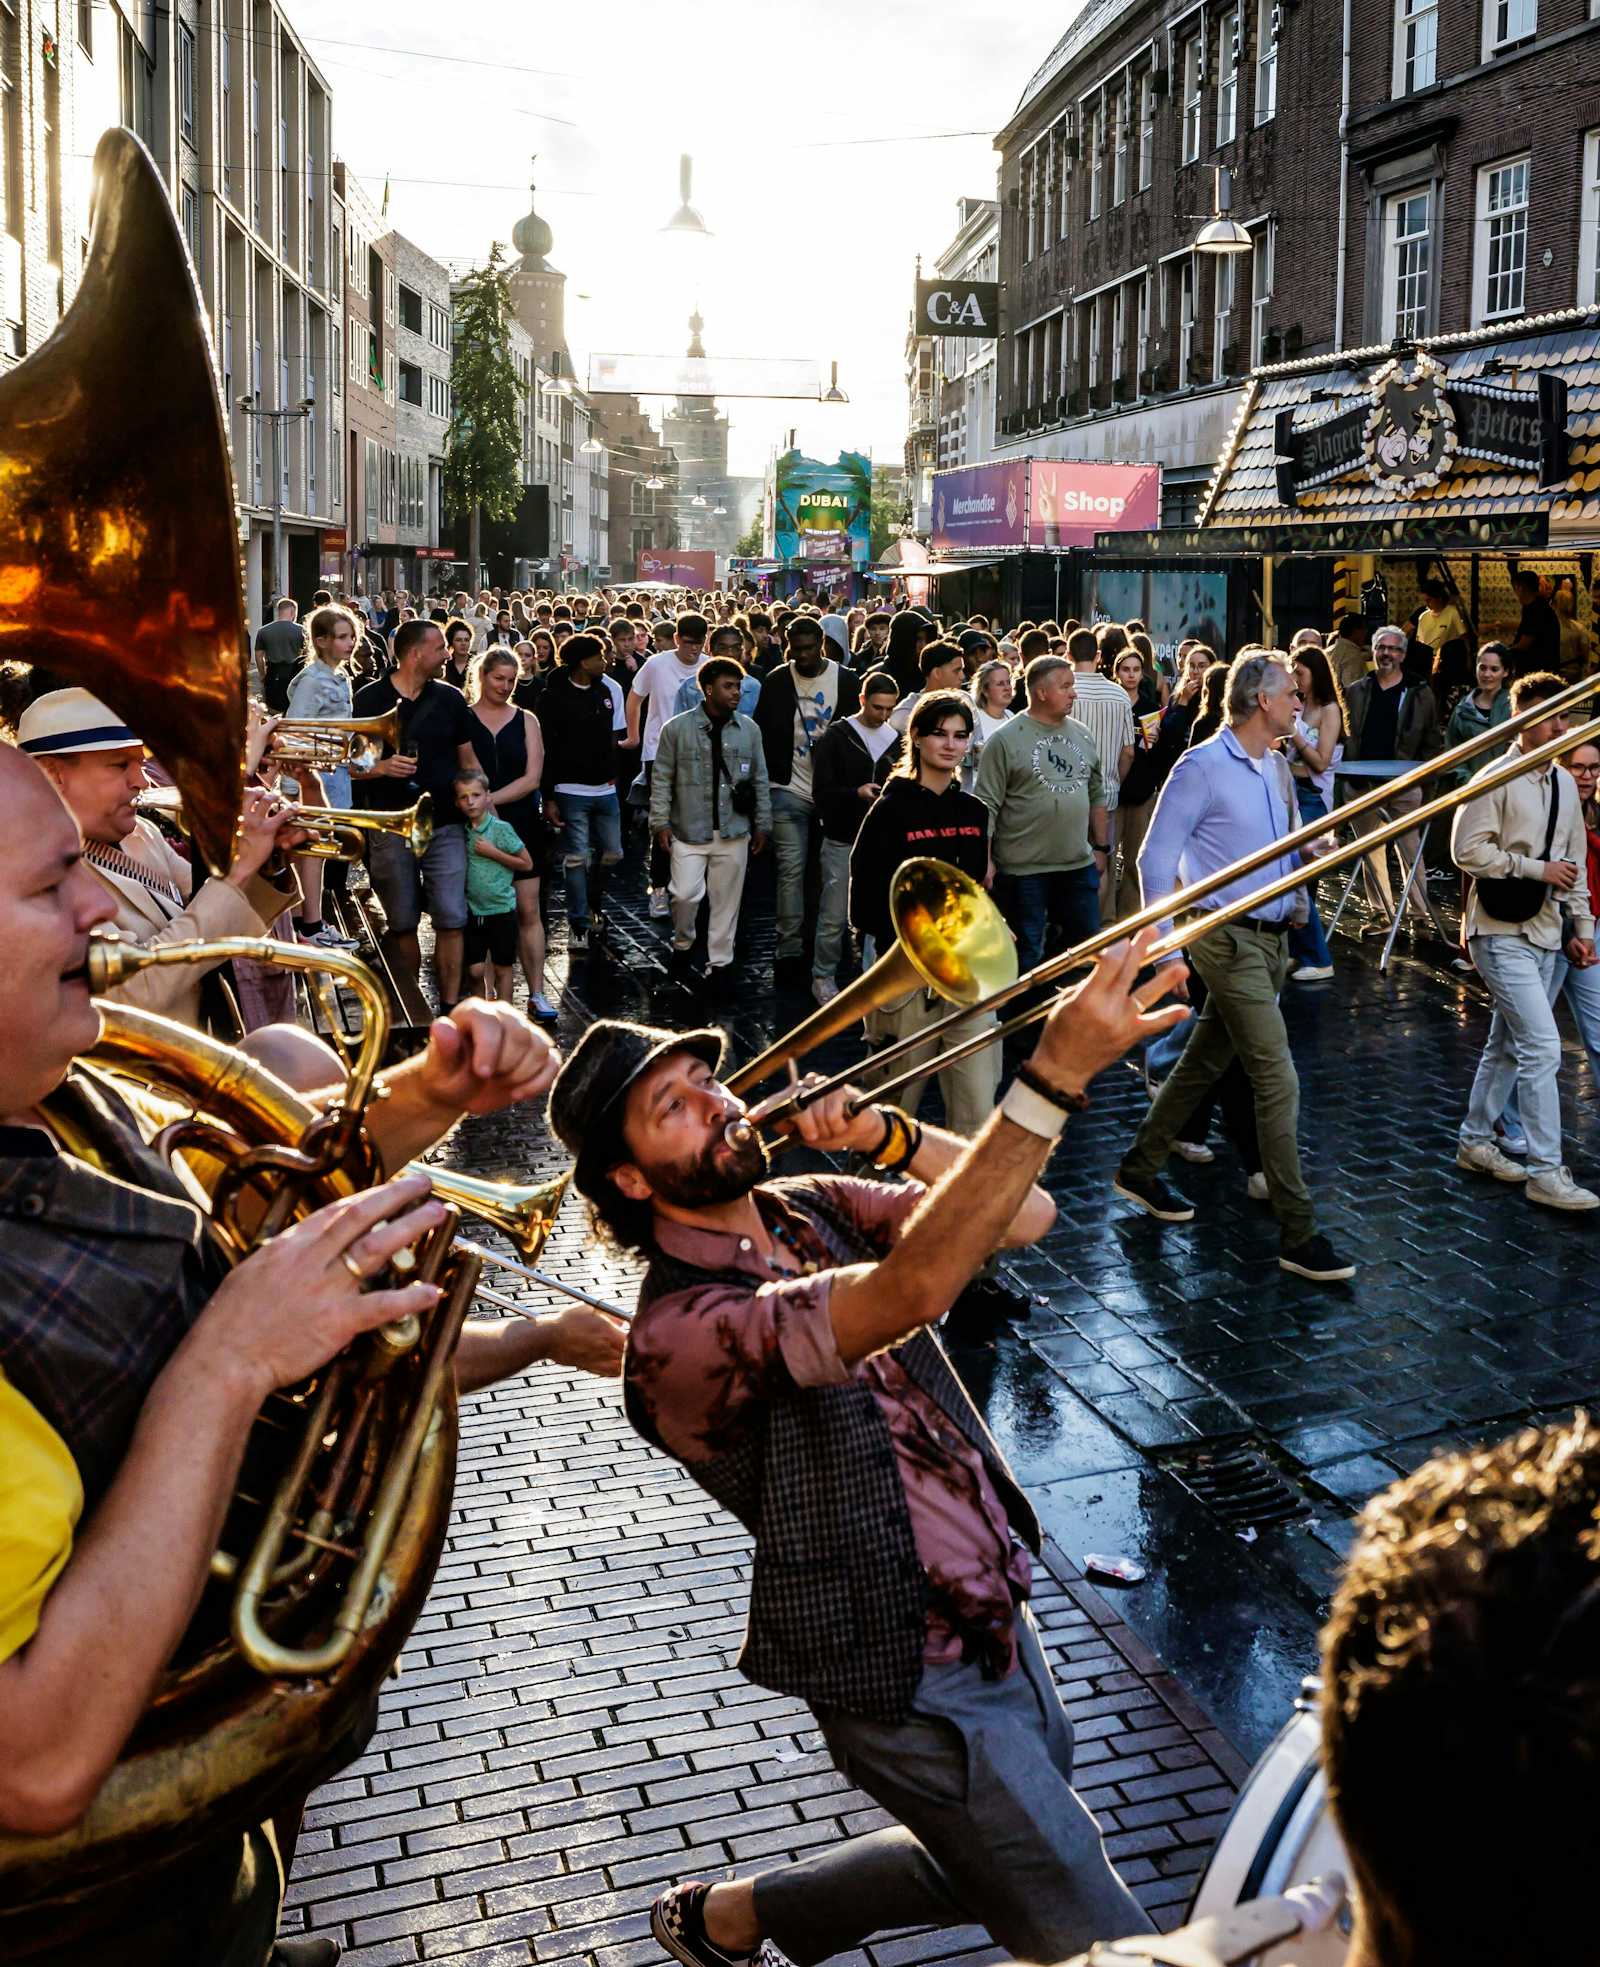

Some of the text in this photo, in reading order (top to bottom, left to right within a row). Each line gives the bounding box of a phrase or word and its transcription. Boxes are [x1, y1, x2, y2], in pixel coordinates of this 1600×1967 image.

[927, 291, 987, 326] C&A
[1469, 400, 1542, 447] Peters
[800, 494, 848, 508] DUBAI
[952, 494, 996, 516] Merchandise
[1064, 491, 1126, 518] Shop
[1047, 748, 1074, 779] 1982
